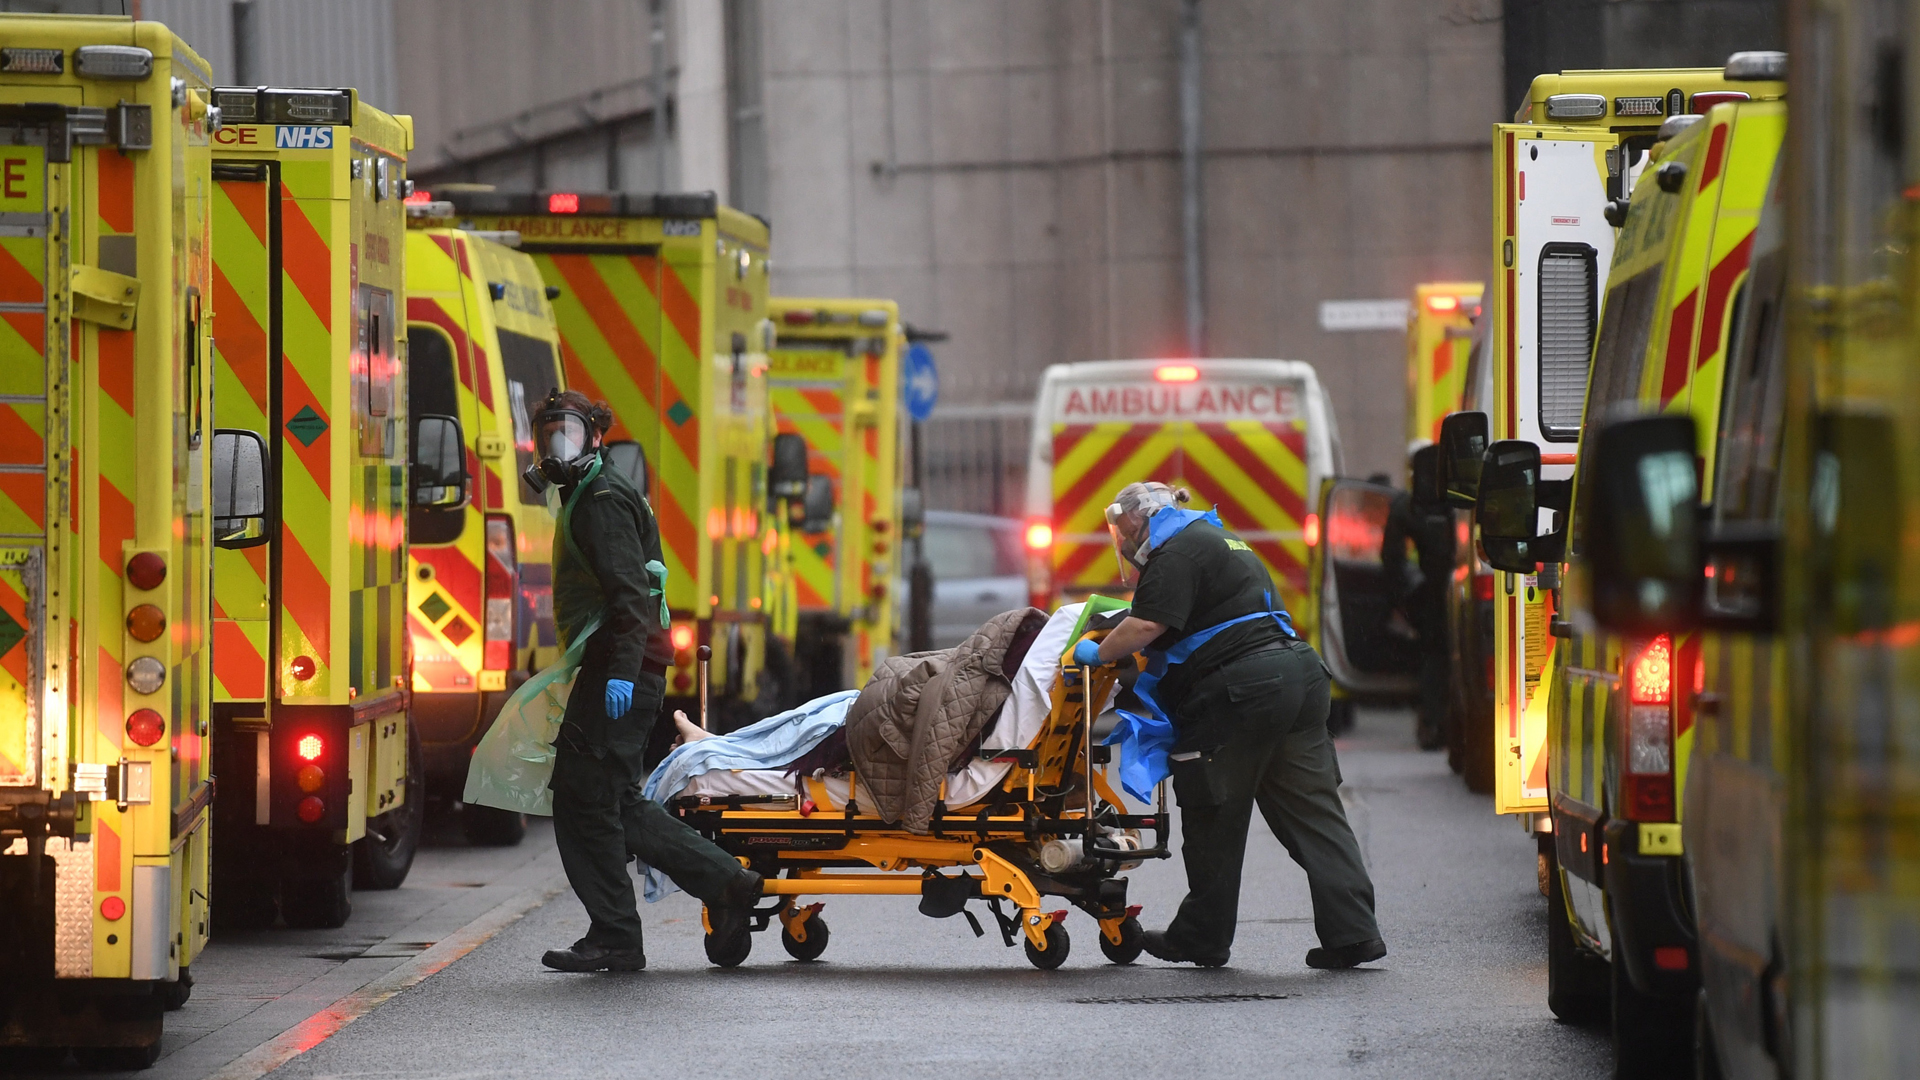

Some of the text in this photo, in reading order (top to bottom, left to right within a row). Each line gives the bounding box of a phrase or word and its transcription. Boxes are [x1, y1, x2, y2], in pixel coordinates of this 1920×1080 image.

[276, 126, 332, 148] NHS
[497, 218, 628, 239] AMBULANCE
[663, 219, 701, 236] NHS
[1064, 387, 1296, 415] AMBULANCE
